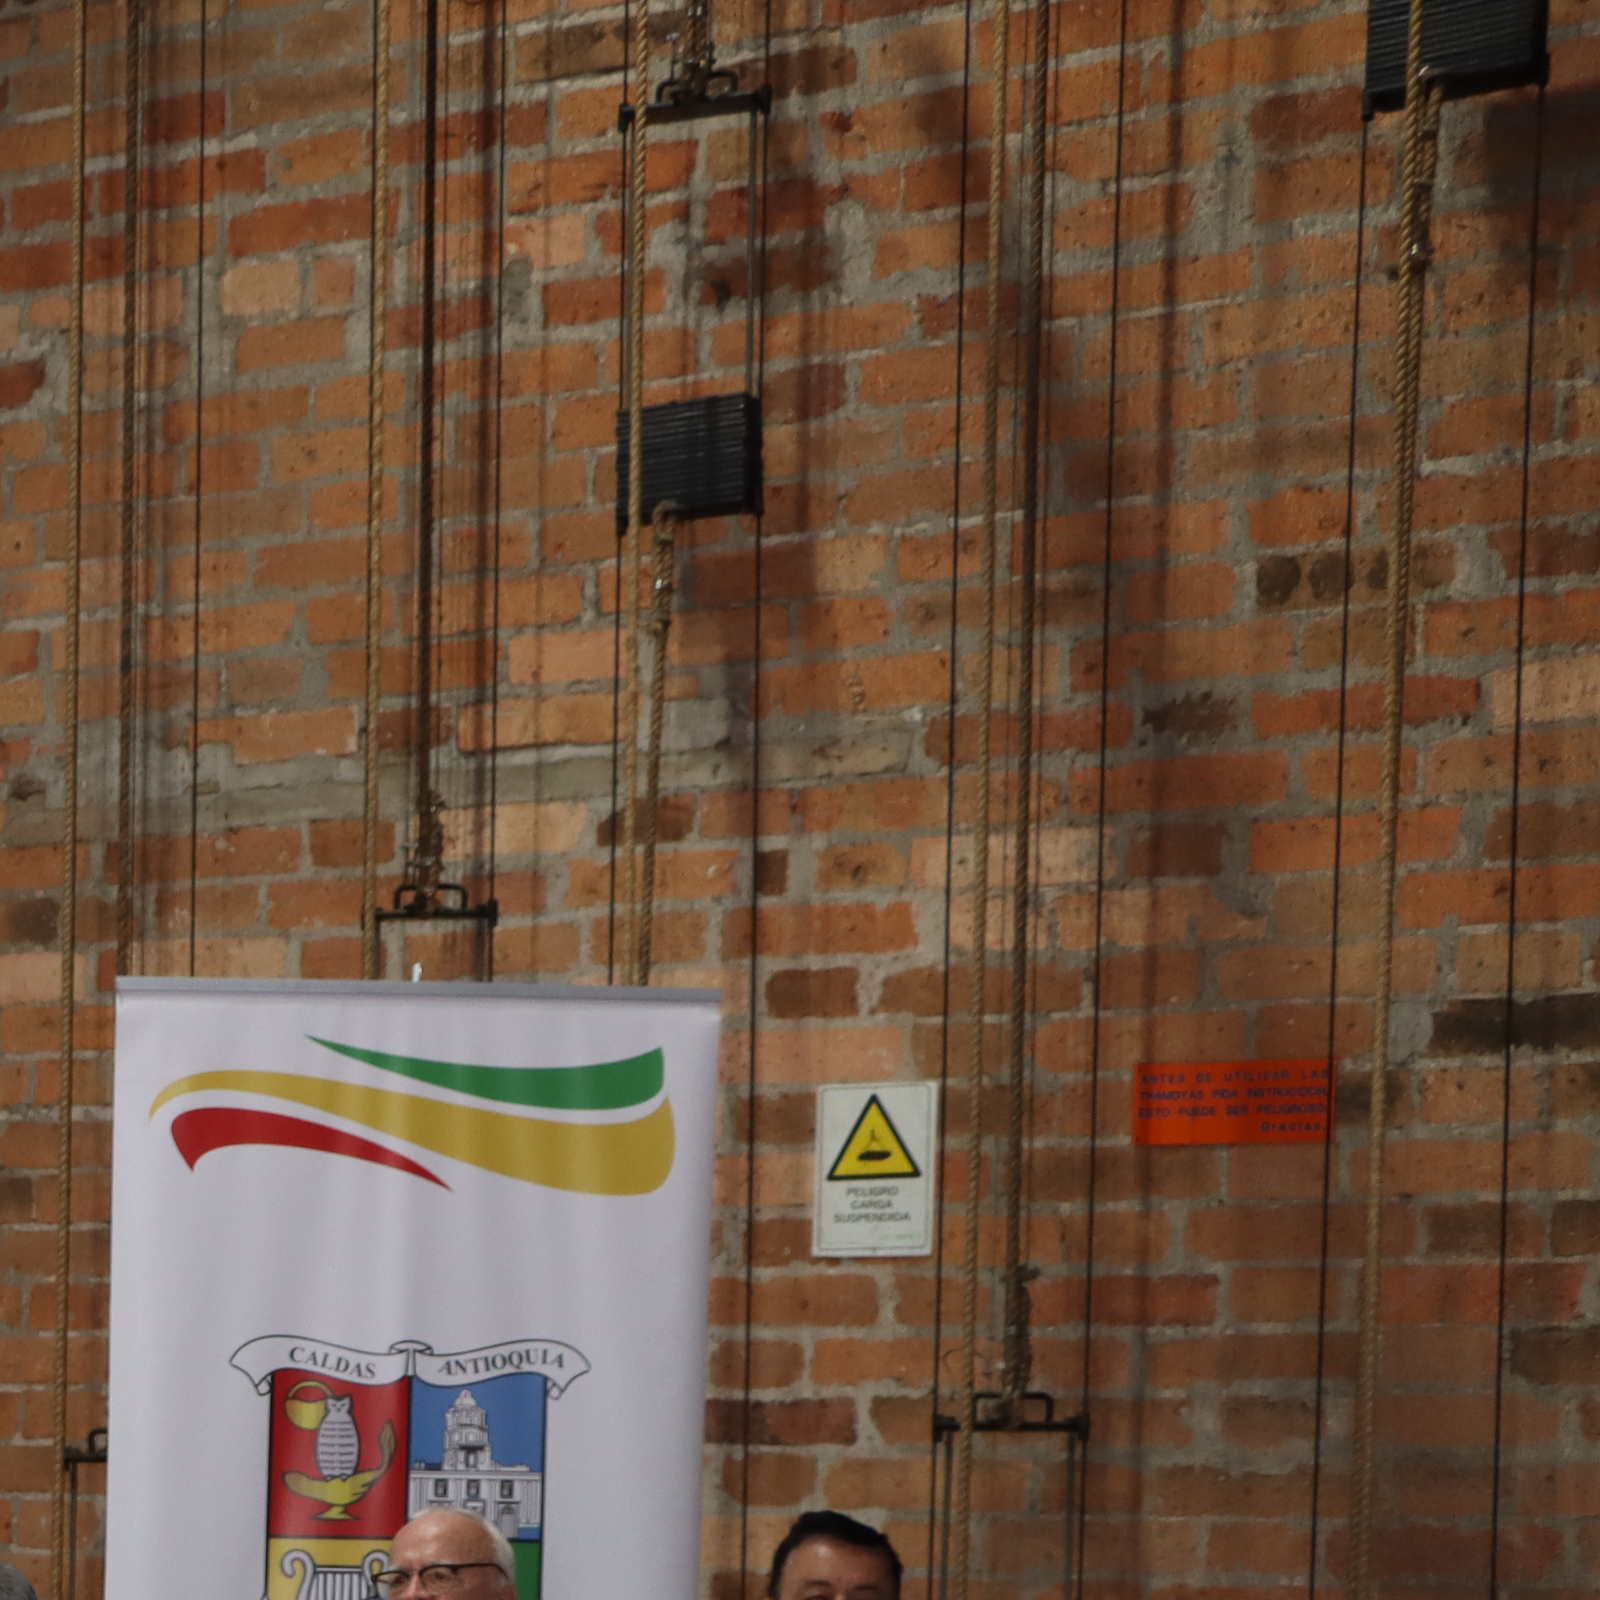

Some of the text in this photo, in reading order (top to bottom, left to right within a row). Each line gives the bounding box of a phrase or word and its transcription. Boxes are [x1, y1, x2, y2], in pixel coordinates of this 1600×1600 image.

[1141, 1072, 1185, 1084] ANTES
[1196, 1072, 1212, 1083] DE
[1224, 1070, 1289, 1082] UTILIZAR
[1138, 1106, 1170, 1118] ESTO
[1178, 1105, 1216, 1117] PUEDE
[1226, 1104, 1248, 1116] SER
[845, 1185, 899, 1197] PELIGRO
[850, 1199, 894, 1211] CARGA
[833, 1211, 912, 1223] SUSPENDIDA
[289, 1346, 376, 1379] CALDAS
[438, 1348, 564, 1376] ANTIOQUIA
